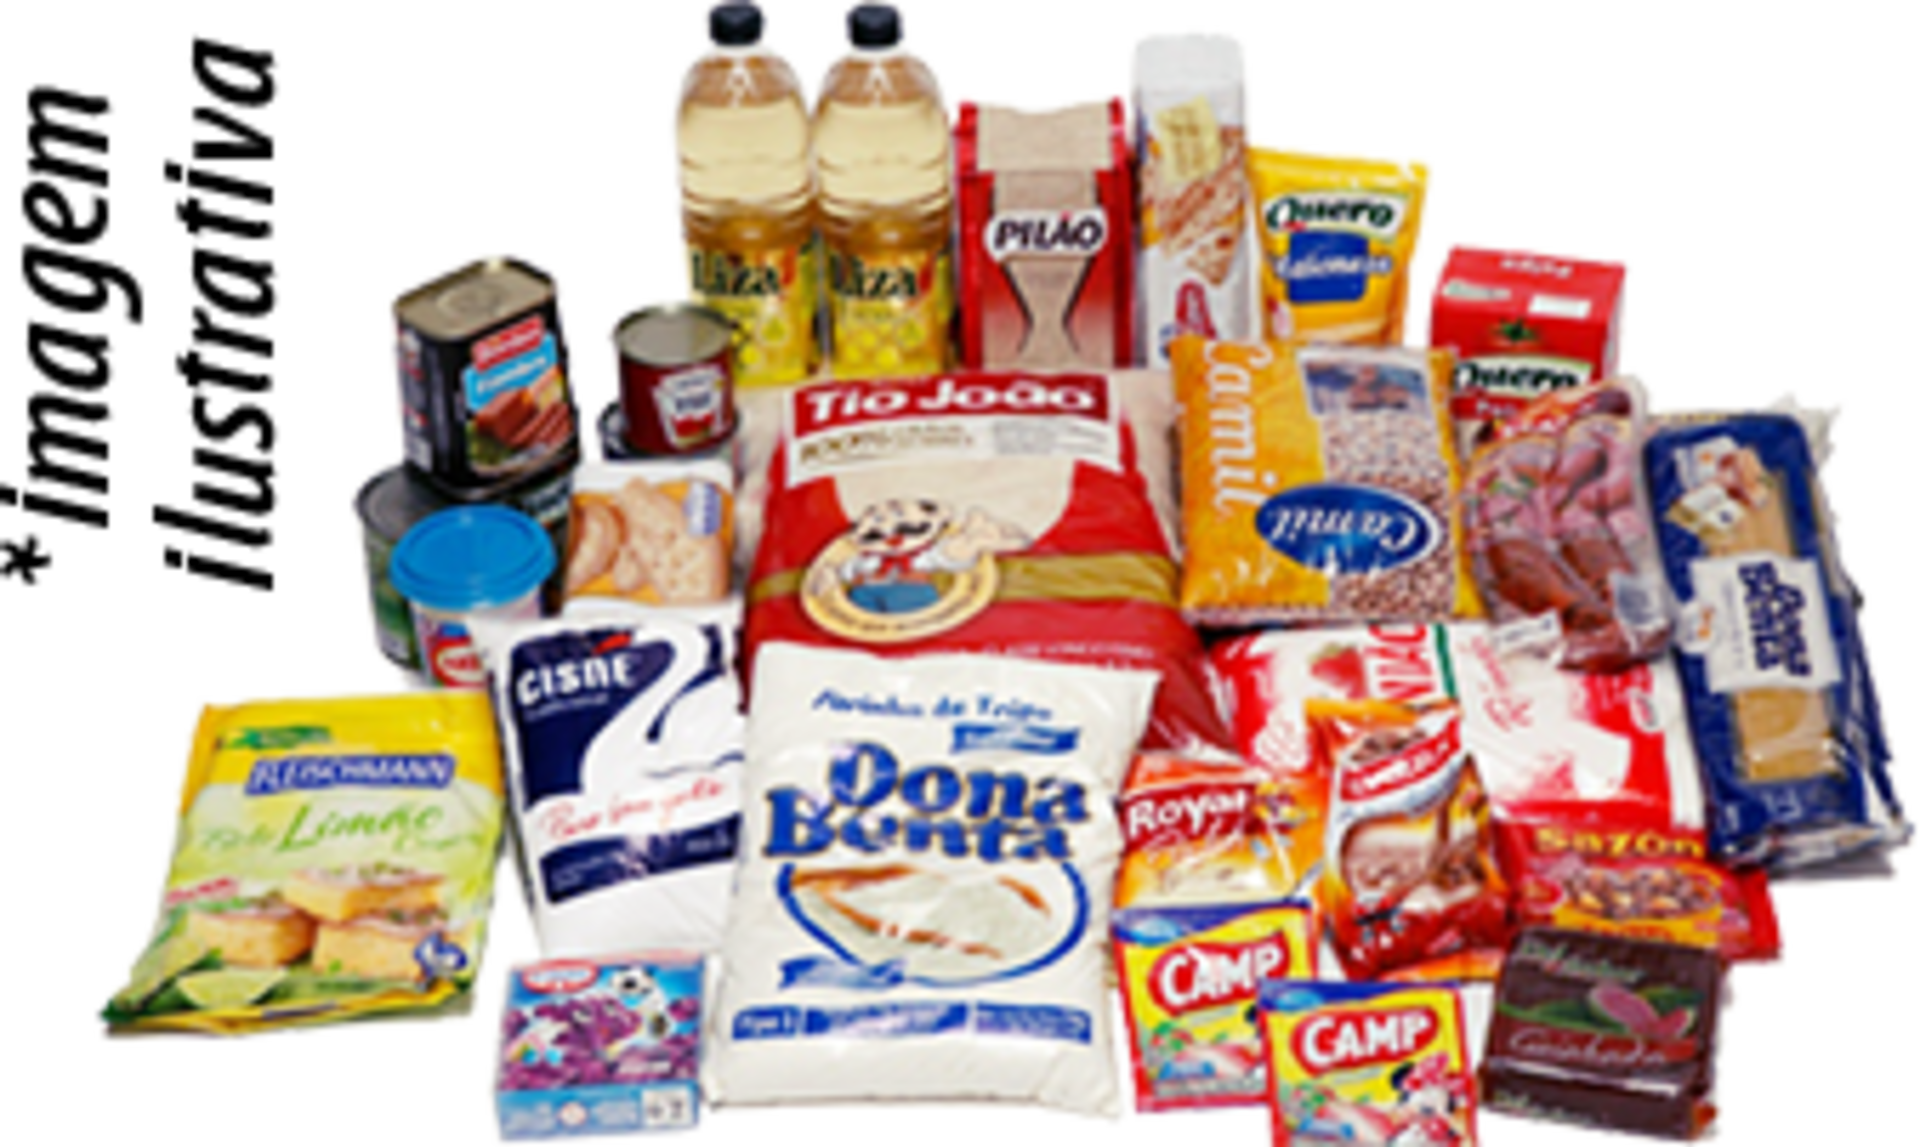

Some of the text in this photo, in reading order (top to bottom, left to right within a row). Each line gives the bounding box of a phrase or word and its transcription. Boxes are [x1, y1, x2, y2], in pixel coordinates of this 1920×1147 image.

[993, 210, 1102, 250] PILÃO
[1265, 196, 1393, 230] Quero
[806, 378, 1096, 423] Tio João
[1204, 340, 1277, 512] Camil
[1270, 479, 1418, 552] Camil
[932, 694, 966, 718] de
[829, 740, 1092, 824] Dona
[1159, 943, 1285, 1006] CAMP
[1302, 1013, 1431, 1067] CAMP
